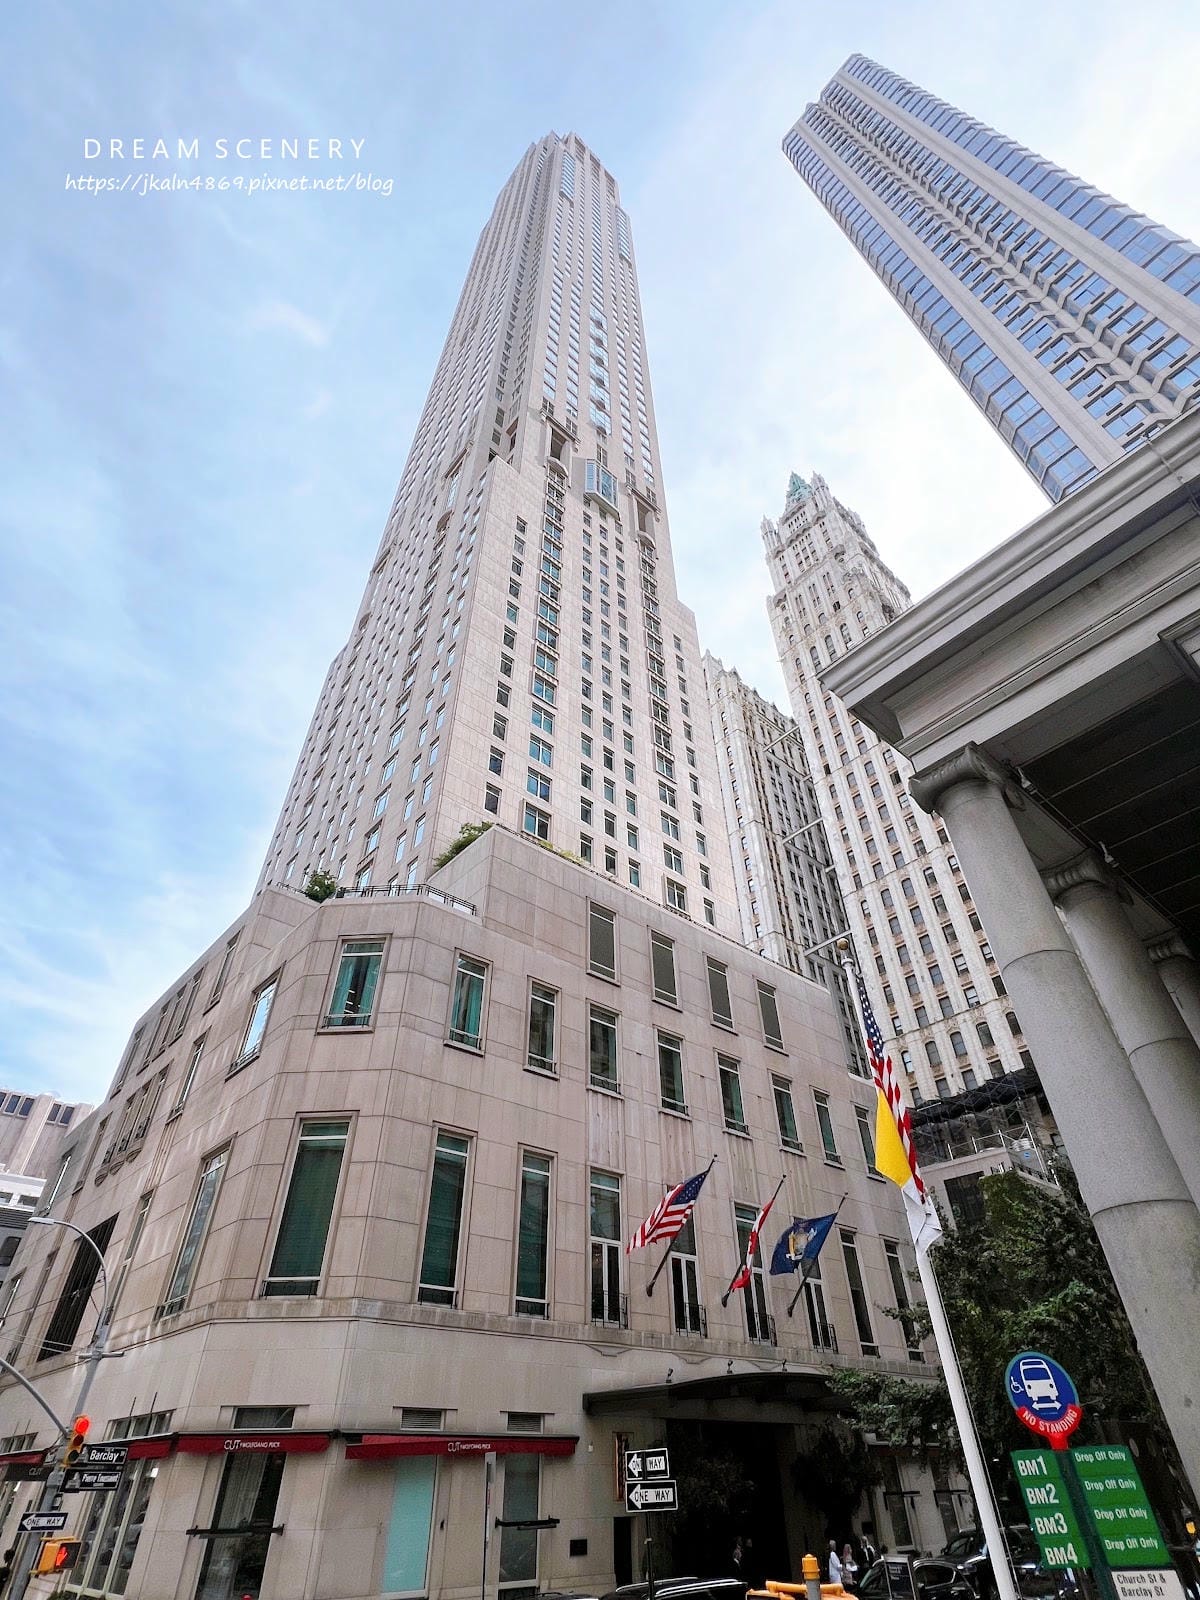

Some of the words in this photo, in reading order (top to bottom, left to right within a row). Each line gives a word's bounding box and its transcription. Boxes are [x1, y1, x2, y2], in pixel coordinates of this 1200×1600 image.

[1022, 1410, 1036, 1426] NO
[1039, 1409, 1078, 1433] STANDING
[224, 1439, 241, 1450] CUT
[89, 1449, 119, 1463] Barclay
[648, 1457, 663, 1469] WAY
[1074, 1452, 1095, 1463] Drop
[1094, 1451, 1107, 1461] Off
[1107, 1450, 1126, 1462] Only
[1017, 1455, 1048, 1476] BM1
[1084, 1480, 1105, 1492] Drop
[1104, 1479, 1118, 1490] Off
[1118, 1479, 1137, 1491] Only
[634, 1490, 649, 1502] ONE
[654, 1489, 670, 1502] WAY
[1026, 1483, 1060, 1505] BM2
[1094, 1509, 1115, 1521] Drop
[1114, 1508, 1128, 1519] Off
[1128, 1507, 1148, 1519] Only
[1034, 1512, 1068, 1535] BM3
[1104, 1539, 1125, 1551] Drop
[1125, 1538, 1139, 1549] Off
[1139, 1537, 1159, 1549] Only
[1044, 1542, 1078, 1566] BM4
[1116, 1573, 1146, 1584] Church
[1147, 1572, 1158, 1583] St
[1158, 1573, 1166, 1583] &
[1121, 1587, 1153, 1597] Barclay
[1154, 1585, 1165, 1596] St
